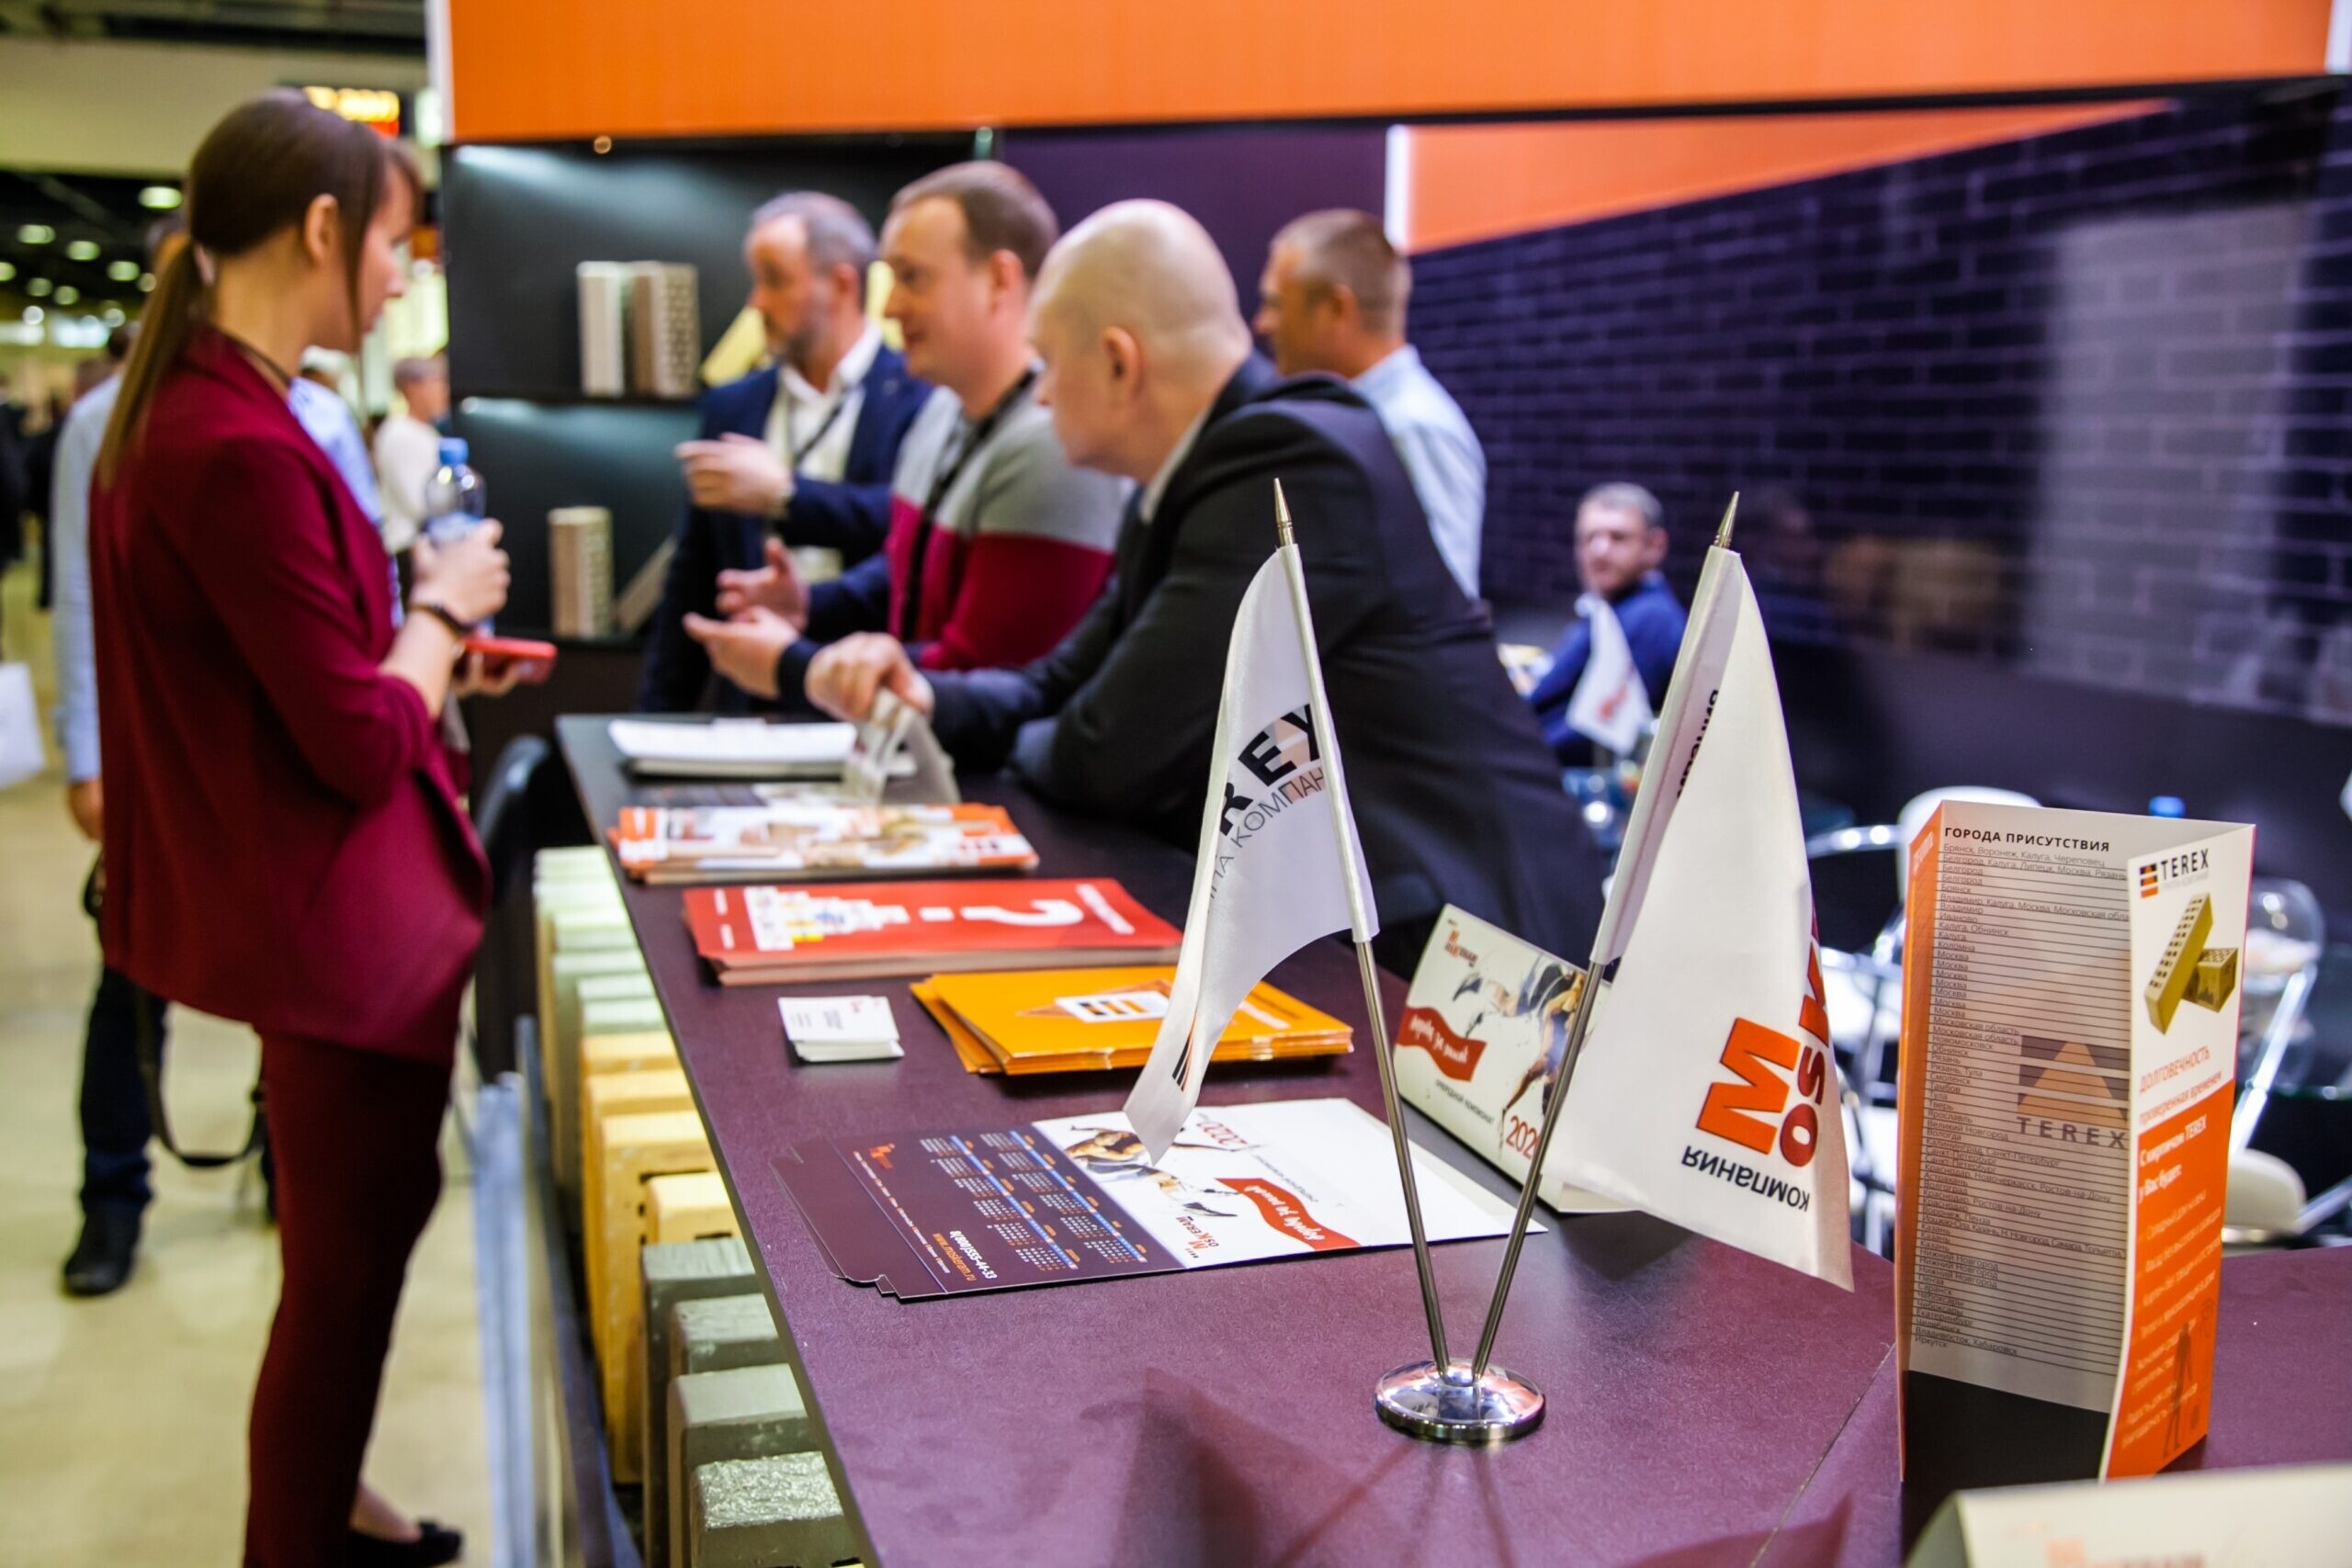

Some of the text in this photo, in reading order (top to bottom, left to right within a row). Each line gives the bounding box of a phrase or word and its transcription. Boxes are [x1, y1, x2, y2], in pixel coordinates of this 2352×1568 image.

[1944, 827, 2109, 852] ГОРОДА ПРИСУТСТВИЯ
[1942, 864, 1983, 875] Белгород
[2161, 848, 2209, 881] TEREX
[1941, 874, 1982, 885] Белгород
[1940, 884, 1970, 893] Брянск
[1939, 903, 1983, 914] Владимир
[1938, 931, 1966, 941] Калуга
[1971, 925, 2008, 936] Обнинск
[1938, 941, 1974, 952] Коломна
[1937, 951, 1968, 961] Москва
[1937, 960, 1968, 970] Москва
[1936, 970, 1967, 980] Москва
[1935, 978, 1966, 989] Москва
[1935, 987, 1966, 998] Москва
[1934, 998, 1965, 1008] Москва
[1934, 1007, 1964, 1018] Москва
[1931, 1044, 1968, 1056] Обнинск
[1931, 1053, 1960, 1064] Рязань
[1964, 1067, 1982, 1077] Тула
[2140, 1045, 2210, 1096] ДОЛГОВЕЧНОСТЬ
[1930, 1072, 1970, 1084] Смоленск
[1695, 1016, 1801, 1156] M
[1929, 1082, 1960, 1093] Тамбов
[1928, 1090, 1947, 1100] Тула
[1928, 1100, 1953, 1111] Тверь
[1928, 1110, 1973, 1124] Ярославль
[1927, 1120, 2007, 1140] Великий Новгород
[1927, 1129, 1961, 1141] Вологда
[2016, 1115, 2126, 1150] TEREX
[1681, 1145, 1810, 1213] компания
[1921, 1223, 1951, 1235] Казань
[1921, 1231, 1950, 1244] Казань
[1920, 1240, 1949, 1252] Казань
[933, 1233, 977, 1281] www.moskeram.ru
[949, 1231, 997, 1279] 8(800)555-44-33
[1919, 1248, 1998, 1271] Нижний Новгород
[1919, 1257, 1997, 1280] Нижний Новгород
[1918, 1266, 1997, 1289] Нижний Новгород
